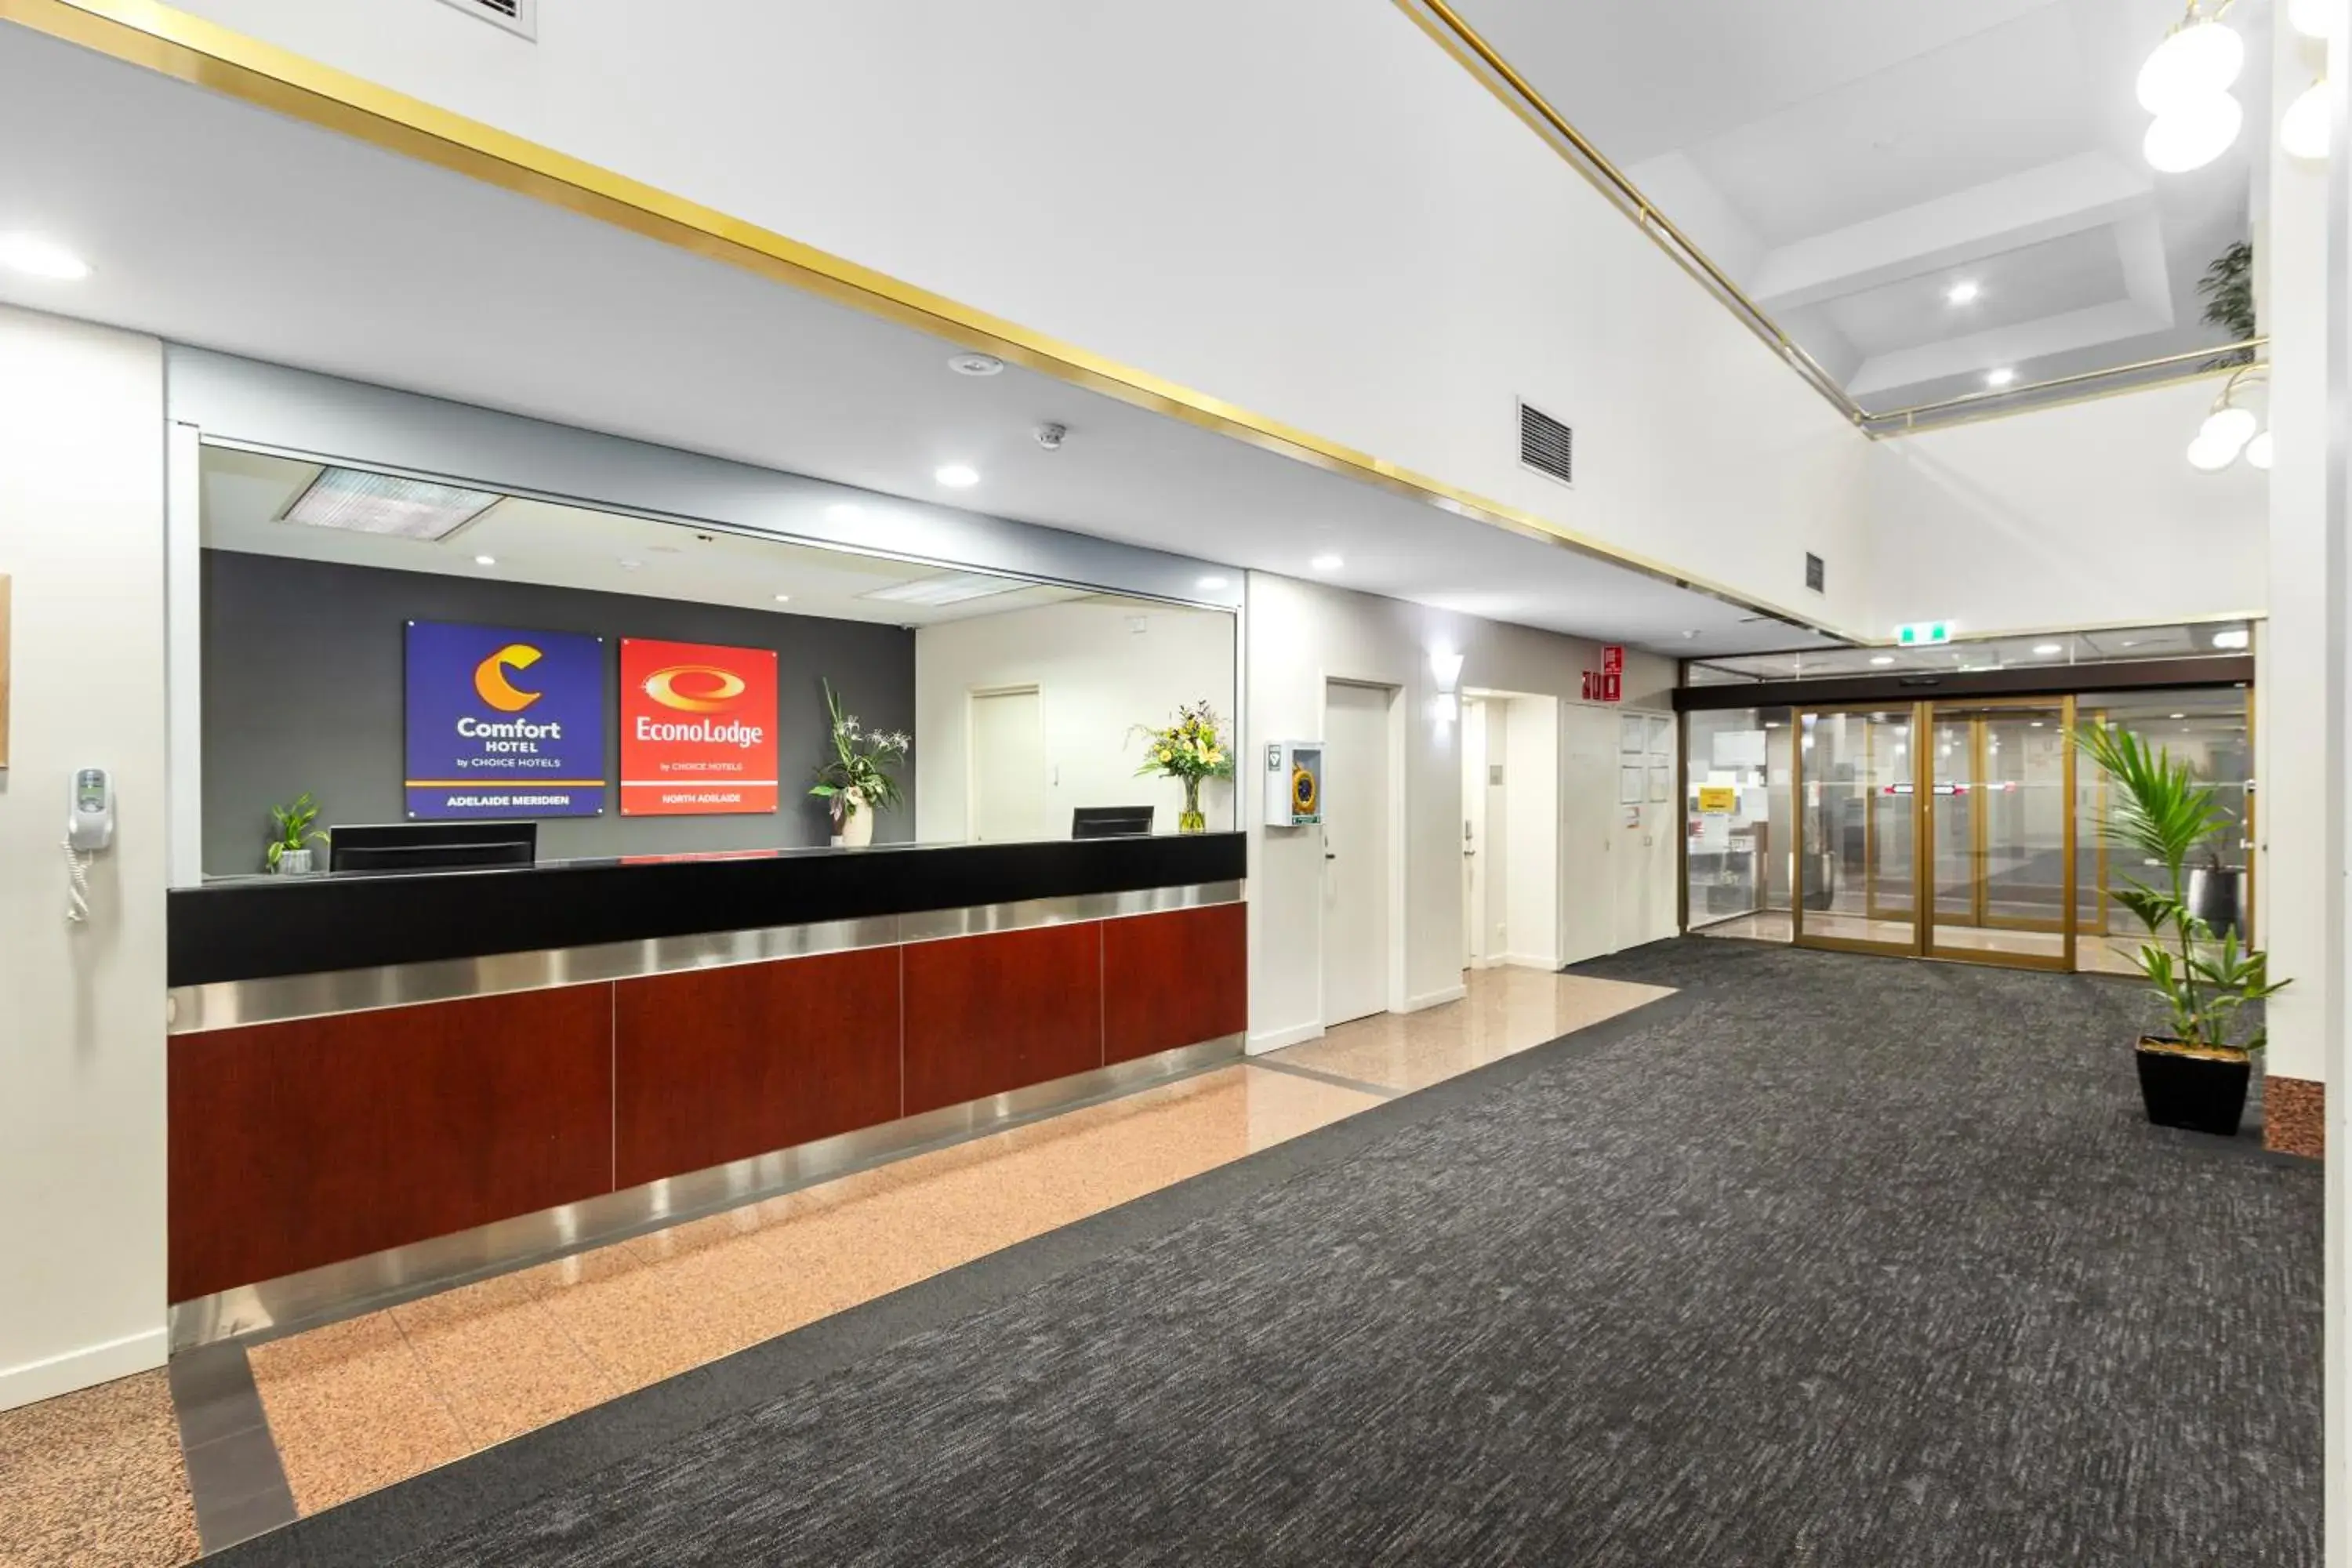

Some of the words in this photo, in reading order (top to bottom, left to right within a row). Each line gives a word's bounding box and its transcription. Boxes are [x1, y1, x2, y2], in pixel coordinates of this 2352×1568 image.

[457, 717, 561, 739] Comfort
[636, 716, 763, 748] EconoLodge
[485, 741, 539, 753] HOTEL
[457, 758, 468, 768] by
[471, 757, 515, 767] CHOICE
[518, 758, 561, 768] HOTELS
[447, 795, 510, 807] ADELAIDE
[512, 794, 570, 806] MERIDIEN
[662, 793, 696, 803] NORTH
[698, 793, 741, 803] ADELAIDE
